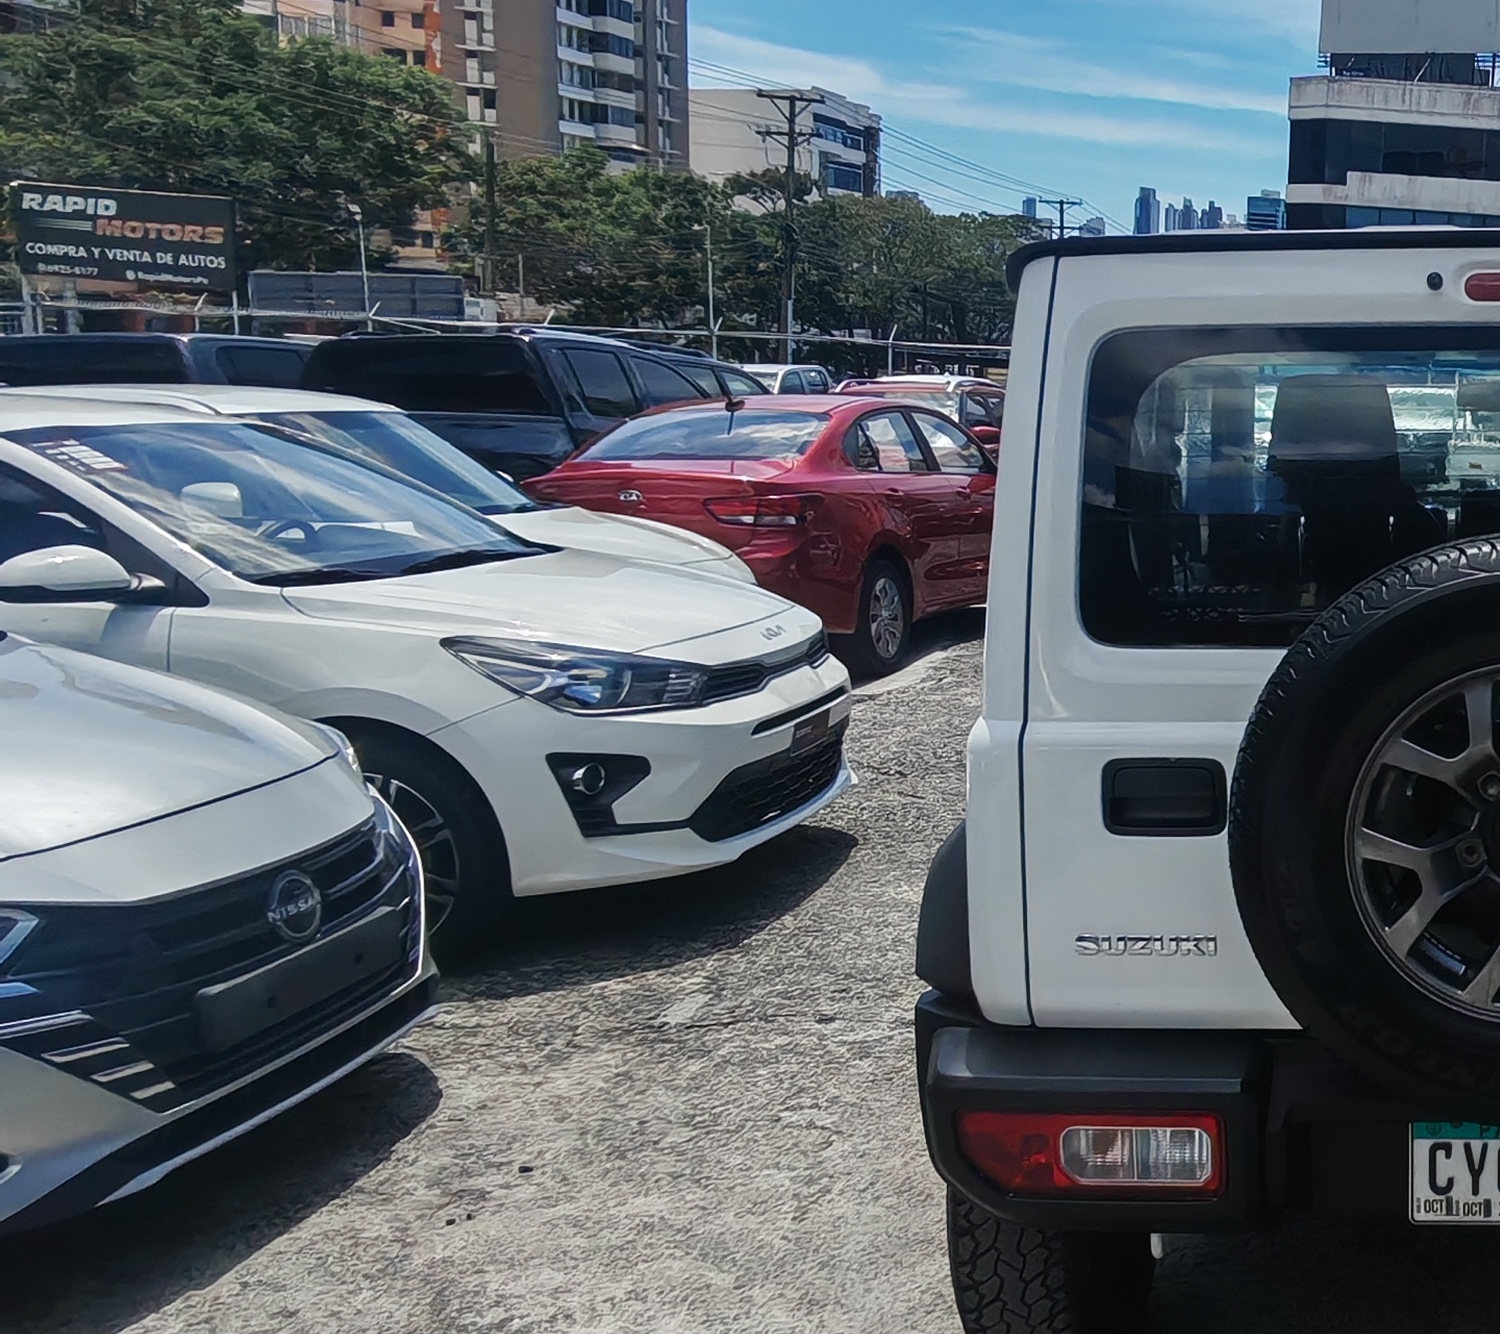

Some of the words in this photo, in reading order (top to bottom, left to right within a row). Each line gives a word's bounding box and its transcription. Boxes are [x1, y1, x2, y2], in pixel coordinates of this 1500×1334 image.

[21, 192, 118, 217] RAPID
[95, 218, 225, 244] MOTORS
[25, 242, 88, 259] COMPRA
[91, 247, 102, 259] Y
[104, 248, 151, 264] VENTA
[156, 252, 174, 266] DE
[178, 254, 226, 269] AUTOS
[1074, 932, 1219, 957] SUZUKI
[1423, 1199, 1444, 1214] OCT
[1462, 1201, 1483, 1217] OCT
